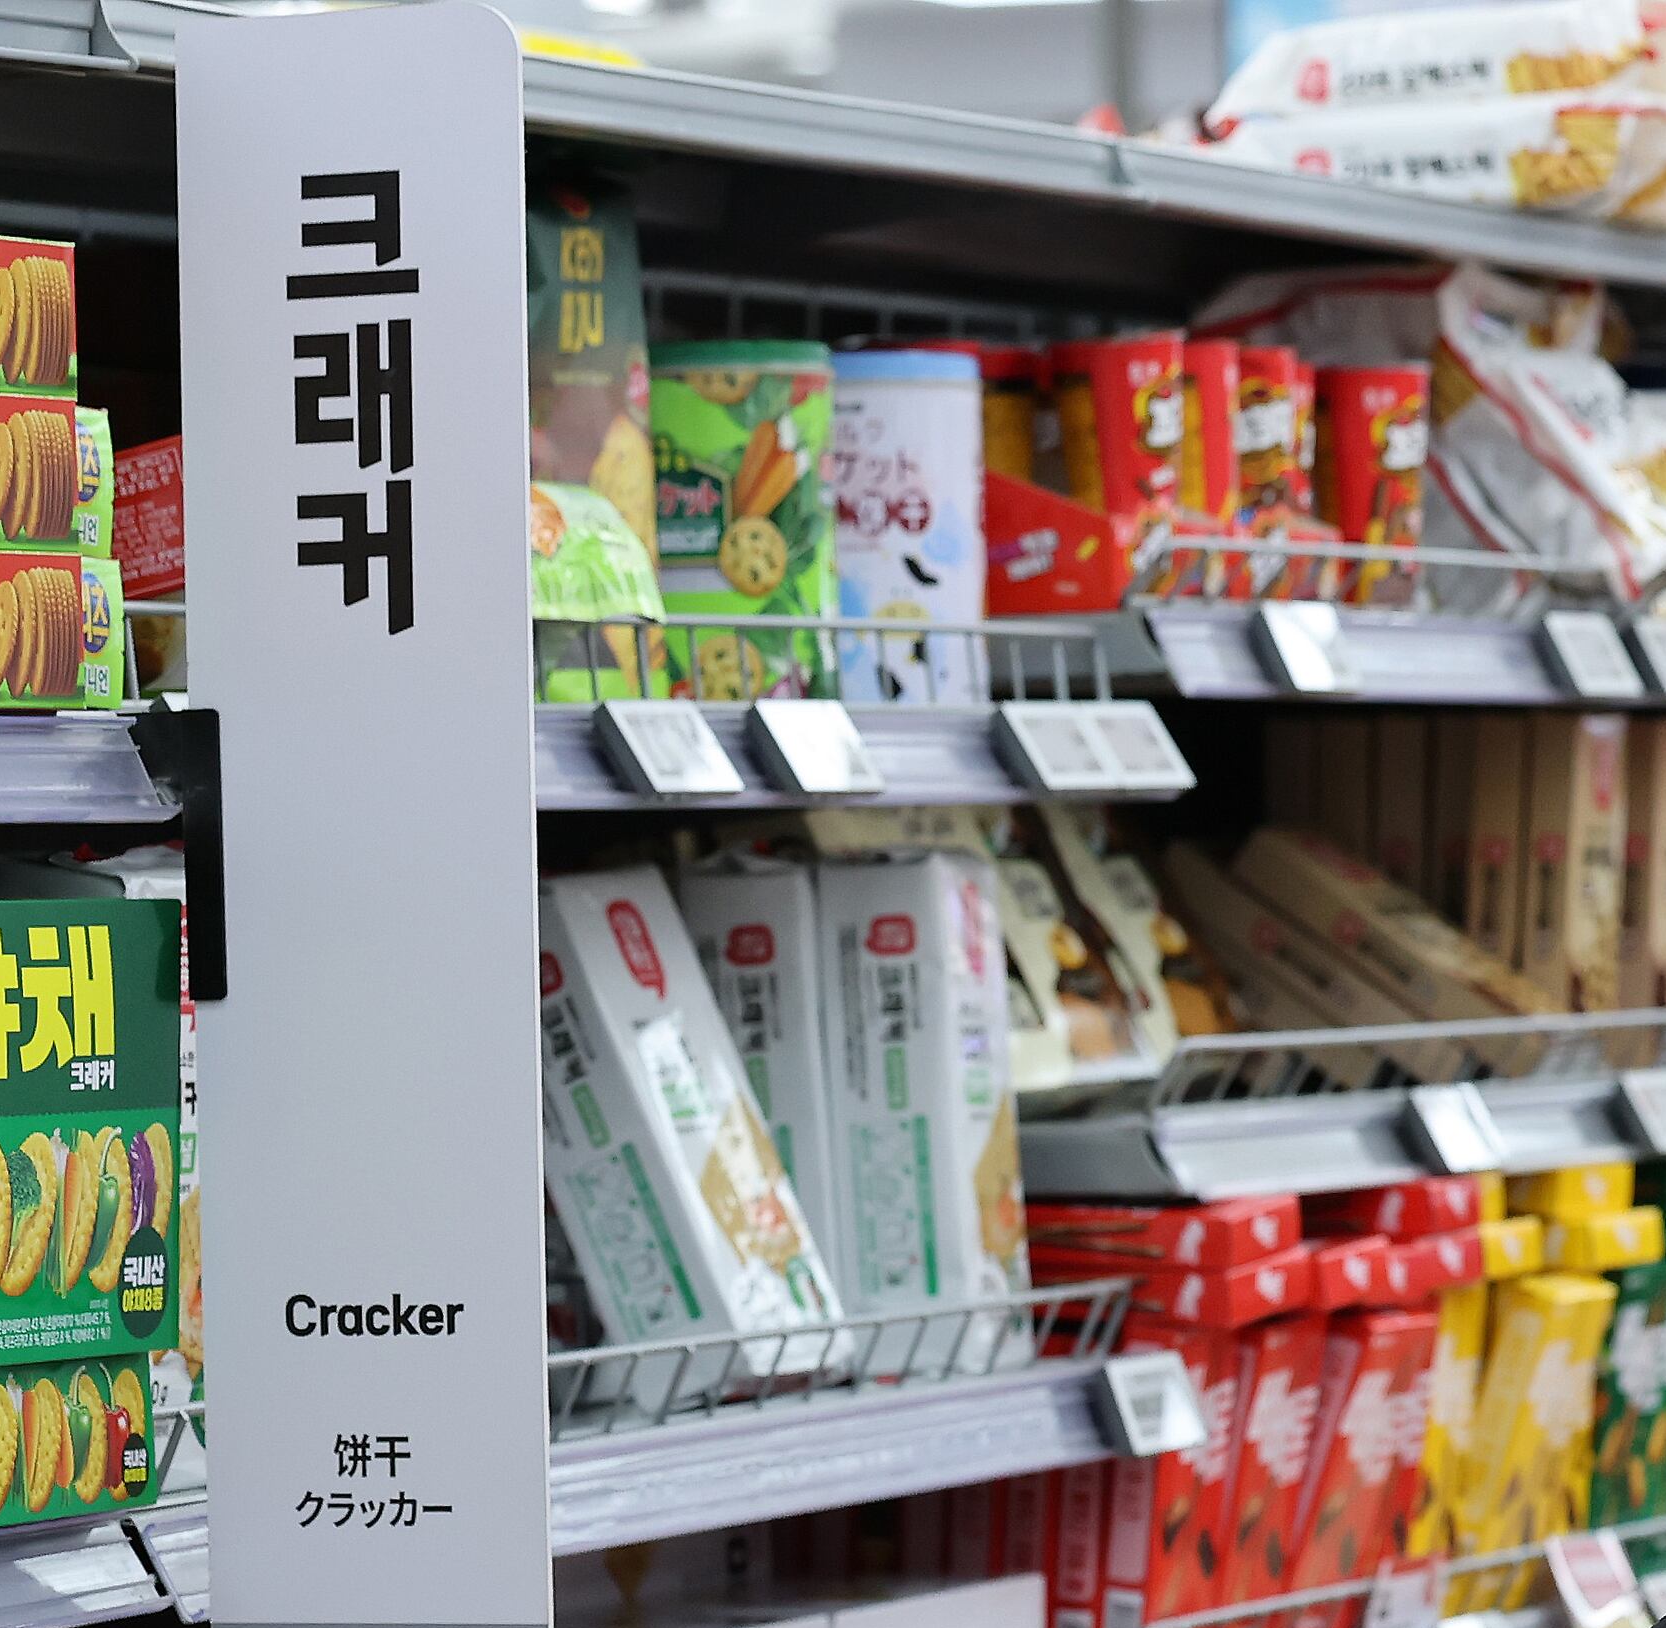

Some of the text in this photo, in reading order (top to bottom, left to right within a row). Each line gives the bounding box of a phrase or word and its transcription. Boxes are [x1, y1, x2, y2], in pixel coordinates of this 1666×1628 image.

[286, 170, 419, 636] 크래커
[69, 1059, 116, 1093] 크래커
[122, 1255, 165, 1290] 국내산
[120, 1286, 165, 1317] 야채8종
[285, 1293, 464, 1337] Cracker
[333, 1433, 411, 1478] 饼干
[295, 1491, 453, 1529] クラッカー
